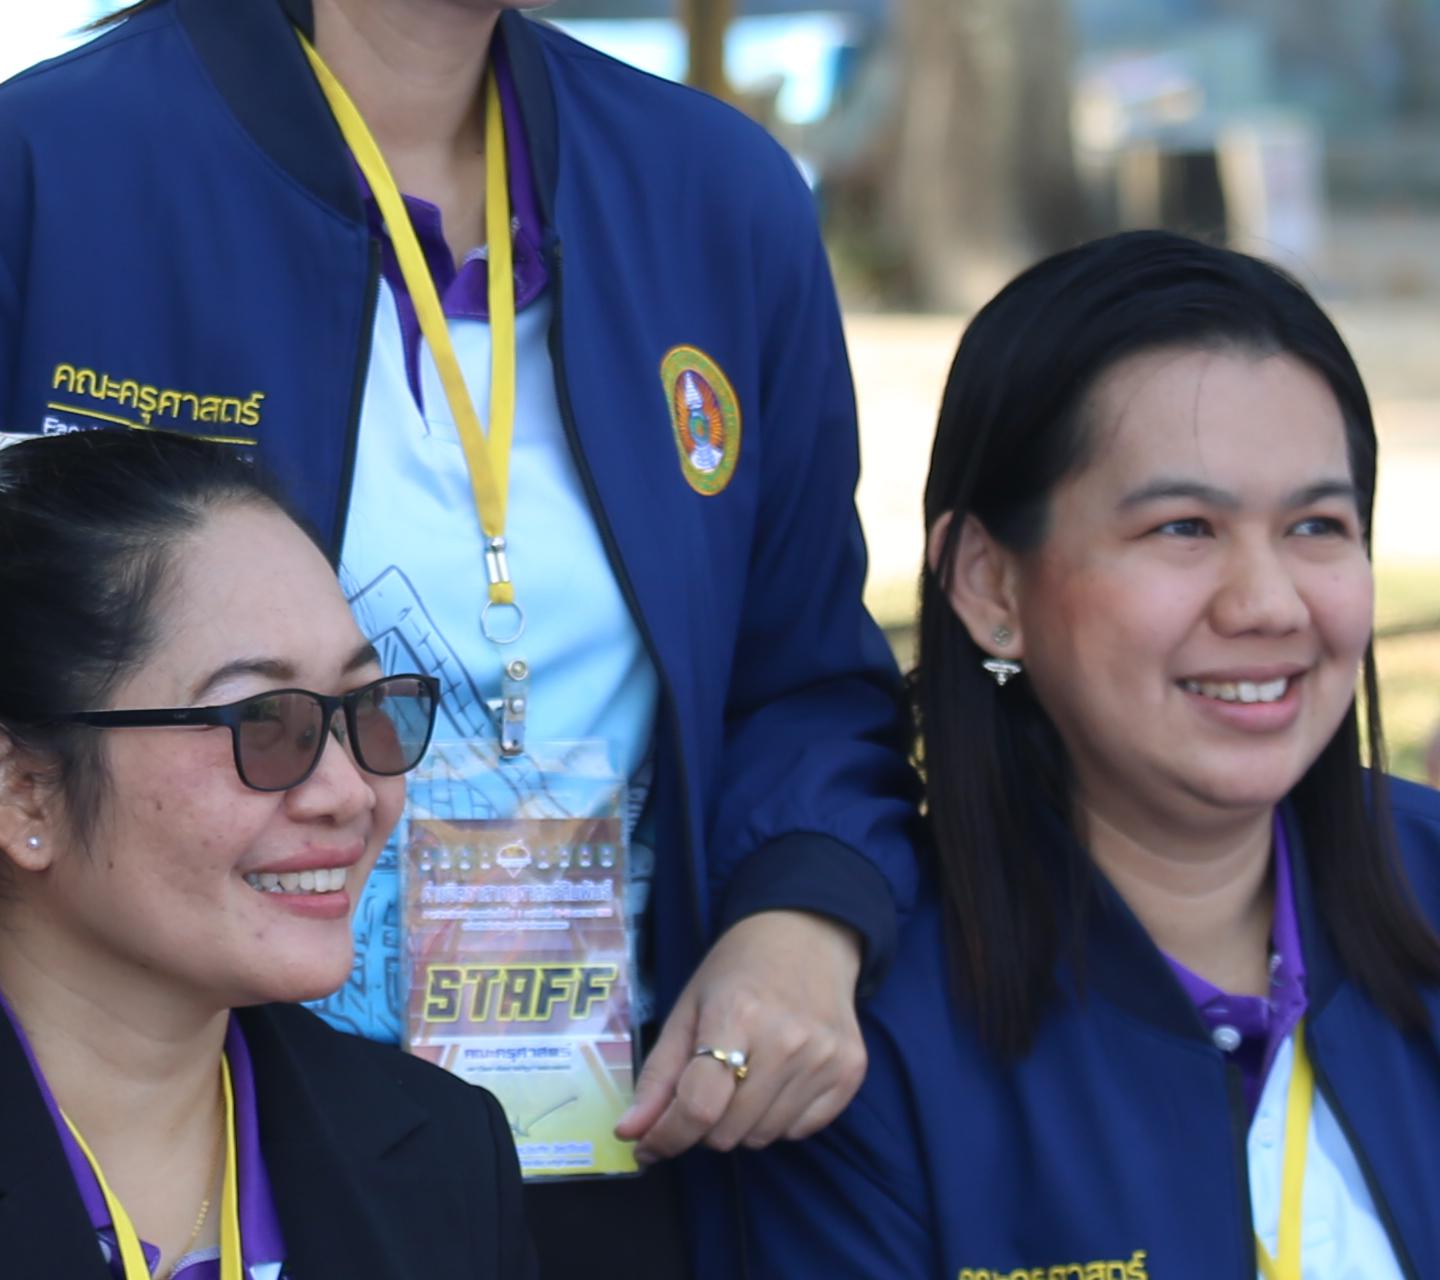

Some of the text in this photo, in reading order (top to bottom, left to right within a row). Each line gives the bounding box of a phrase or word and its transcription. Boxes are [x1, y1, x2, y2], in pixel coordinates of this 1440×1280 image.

[52, 363, 265, 426] คณะครุศาสตร์
[425, 965, 617, 1022] STAFF
